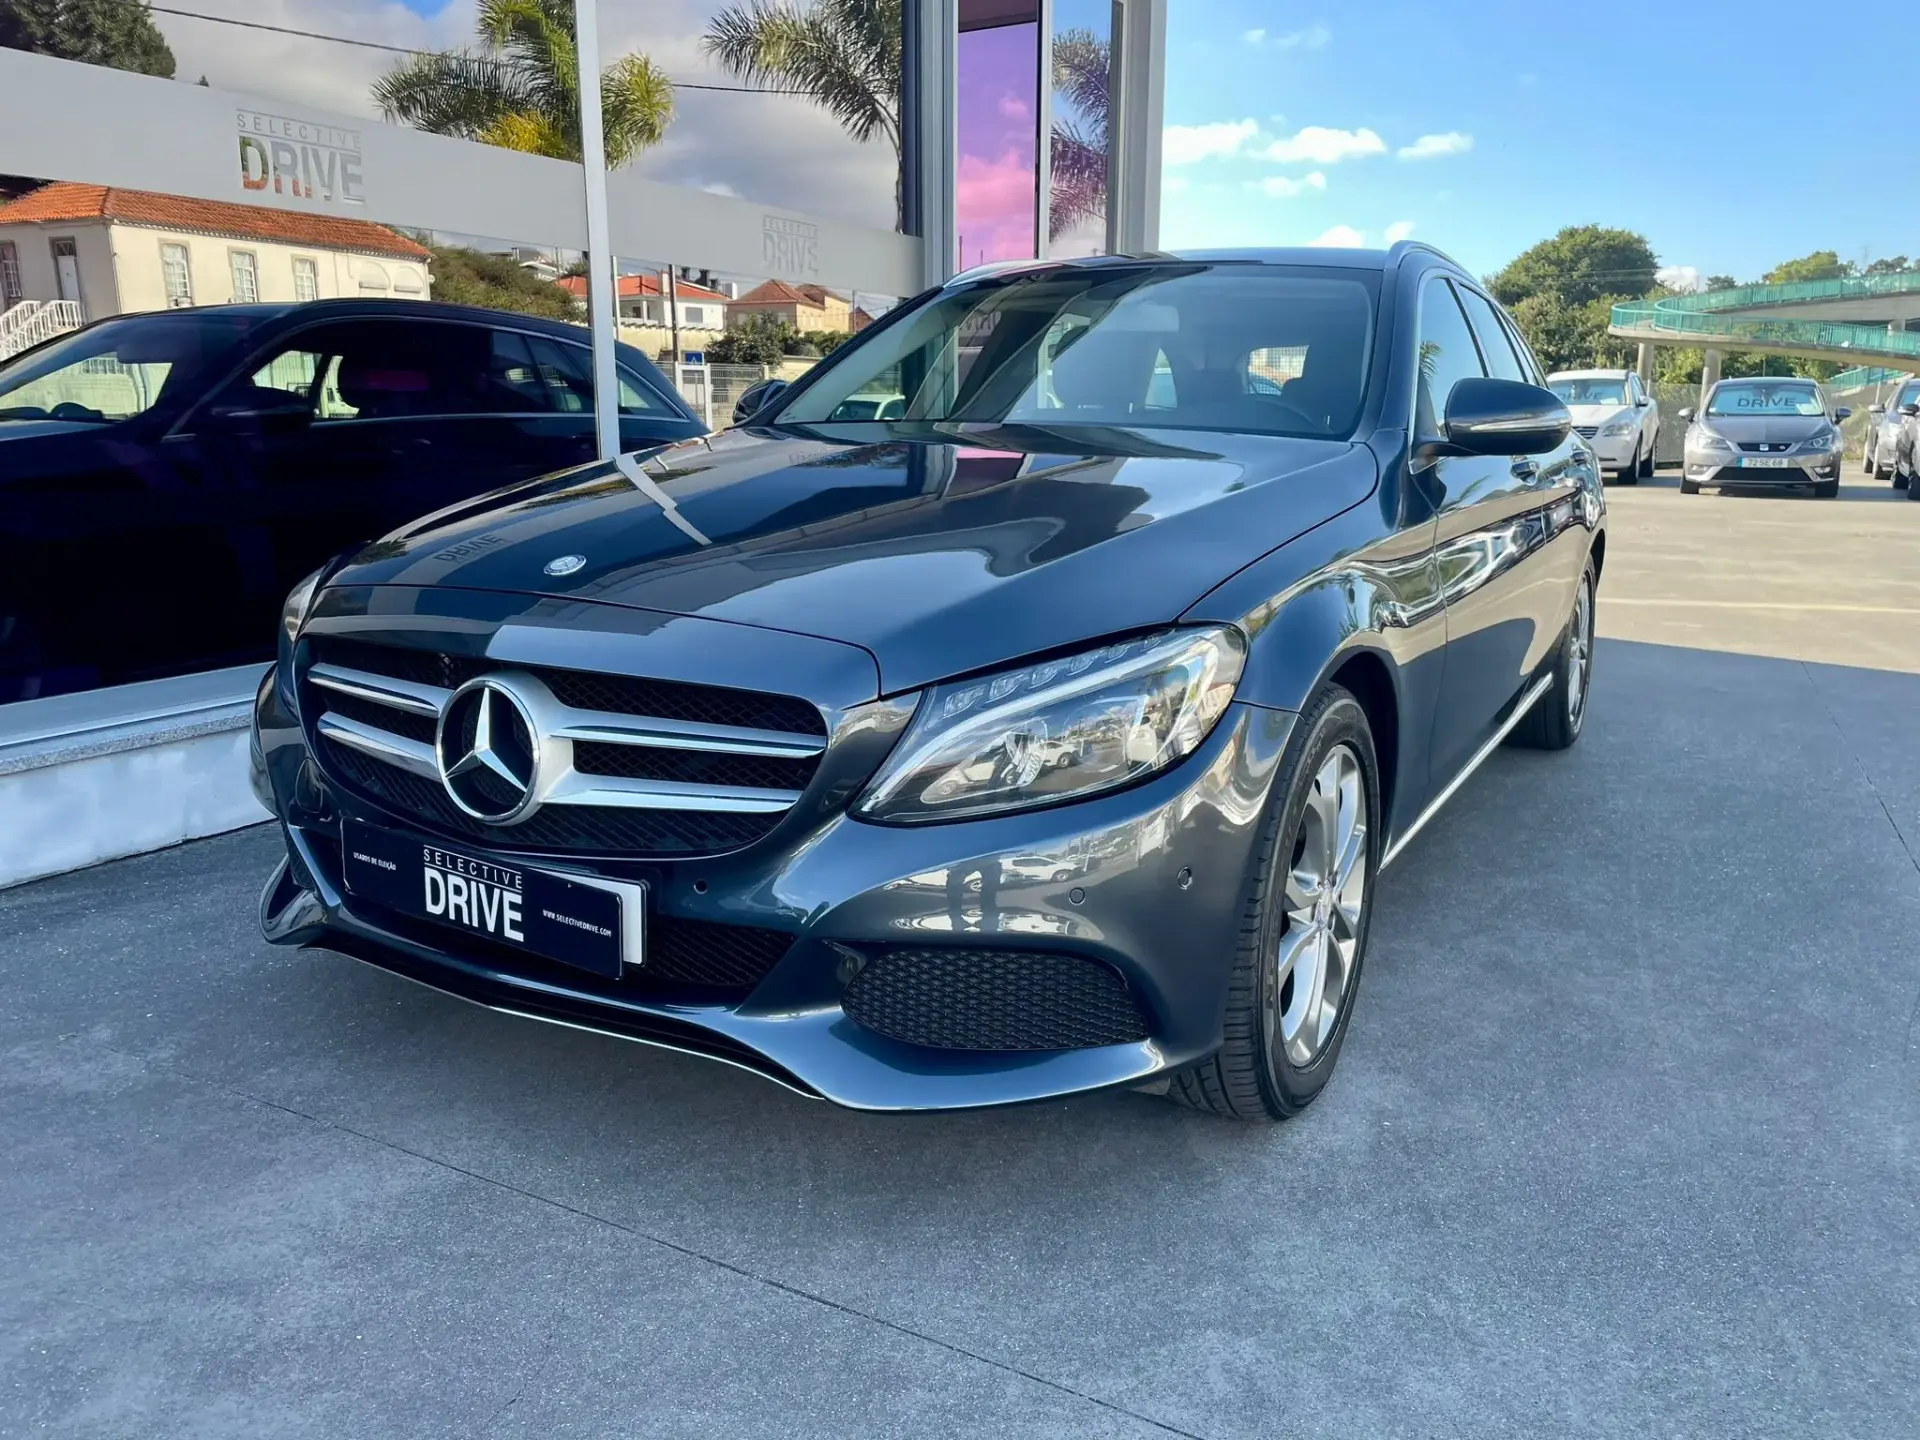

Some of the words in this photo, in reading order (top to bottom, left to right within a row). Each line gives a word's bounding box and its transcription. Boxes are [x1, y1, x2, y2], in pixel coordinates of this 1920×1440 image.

[237, 113, 361, 149] SELECTIVE
[239, 135, 366, 202] DRIVE
[763, 231, 819, 275] DRIVE
[1737, 397, 1796, 408] DRIVE
[423, 848, 522, 889] SELECTIVE
[424, 866, 524, 942] DRIVE
